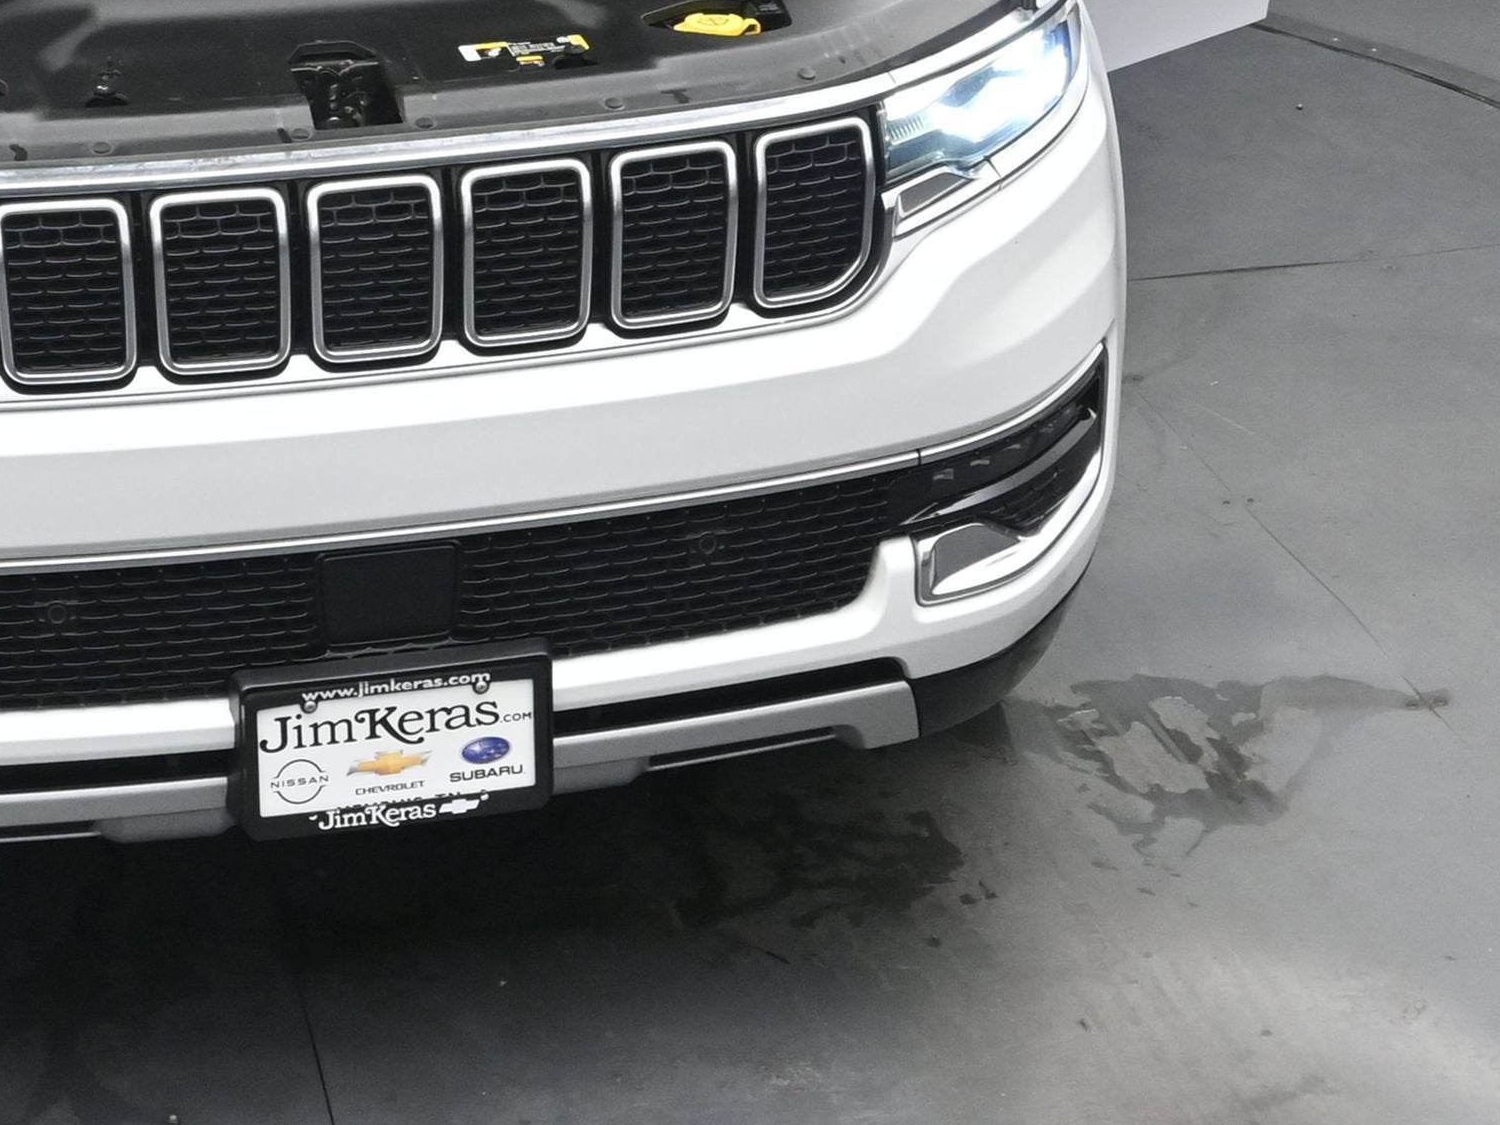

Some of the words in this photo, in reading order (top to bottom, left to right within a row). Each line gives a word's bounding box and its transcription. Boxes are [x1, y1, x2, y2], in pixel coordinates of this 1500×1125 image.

[301, 672, 491, 702] www.jimkeras.com
[270, 774, 330, 790] NISSAN
[449, 764, 524, 783] SUBARU
[355, 780, 425, 795] CHEVROLET
